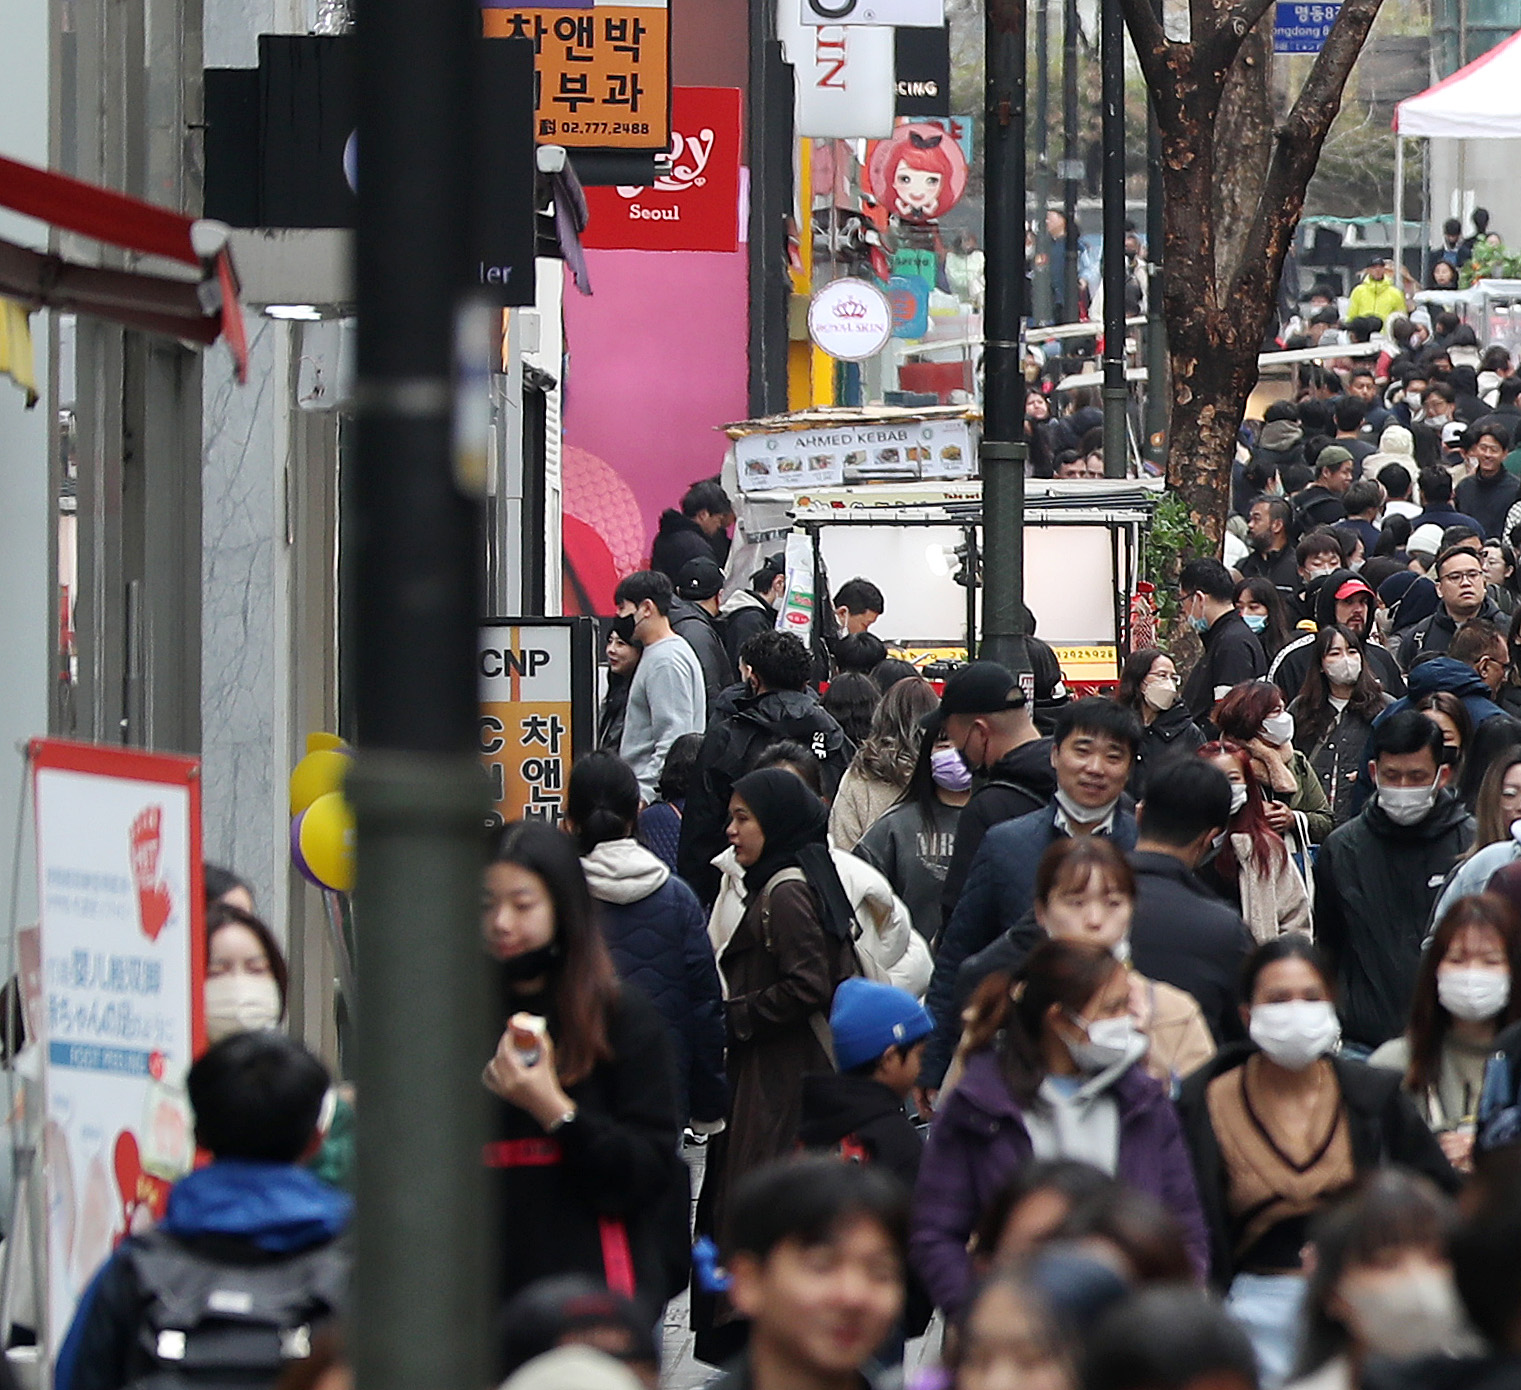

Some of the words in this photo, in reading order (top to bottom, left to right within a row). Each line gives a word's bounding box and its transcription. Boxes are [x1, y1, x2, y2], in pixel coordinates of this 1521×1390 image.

[1271, 25, 1320, 39] ongdong
[534, 70, 645, 113] 부과
[895, 79, 939, 98] CING
[561, 121, 650, 135] 02.777.2488
[629, 204, 680, 221] Seoul
[480, 261, 513, 284] ler
[794, 430, 853, 449] AHMED
[857, 427, 908, 443] KEBAB
[480, 649, 552, 678] CNP
